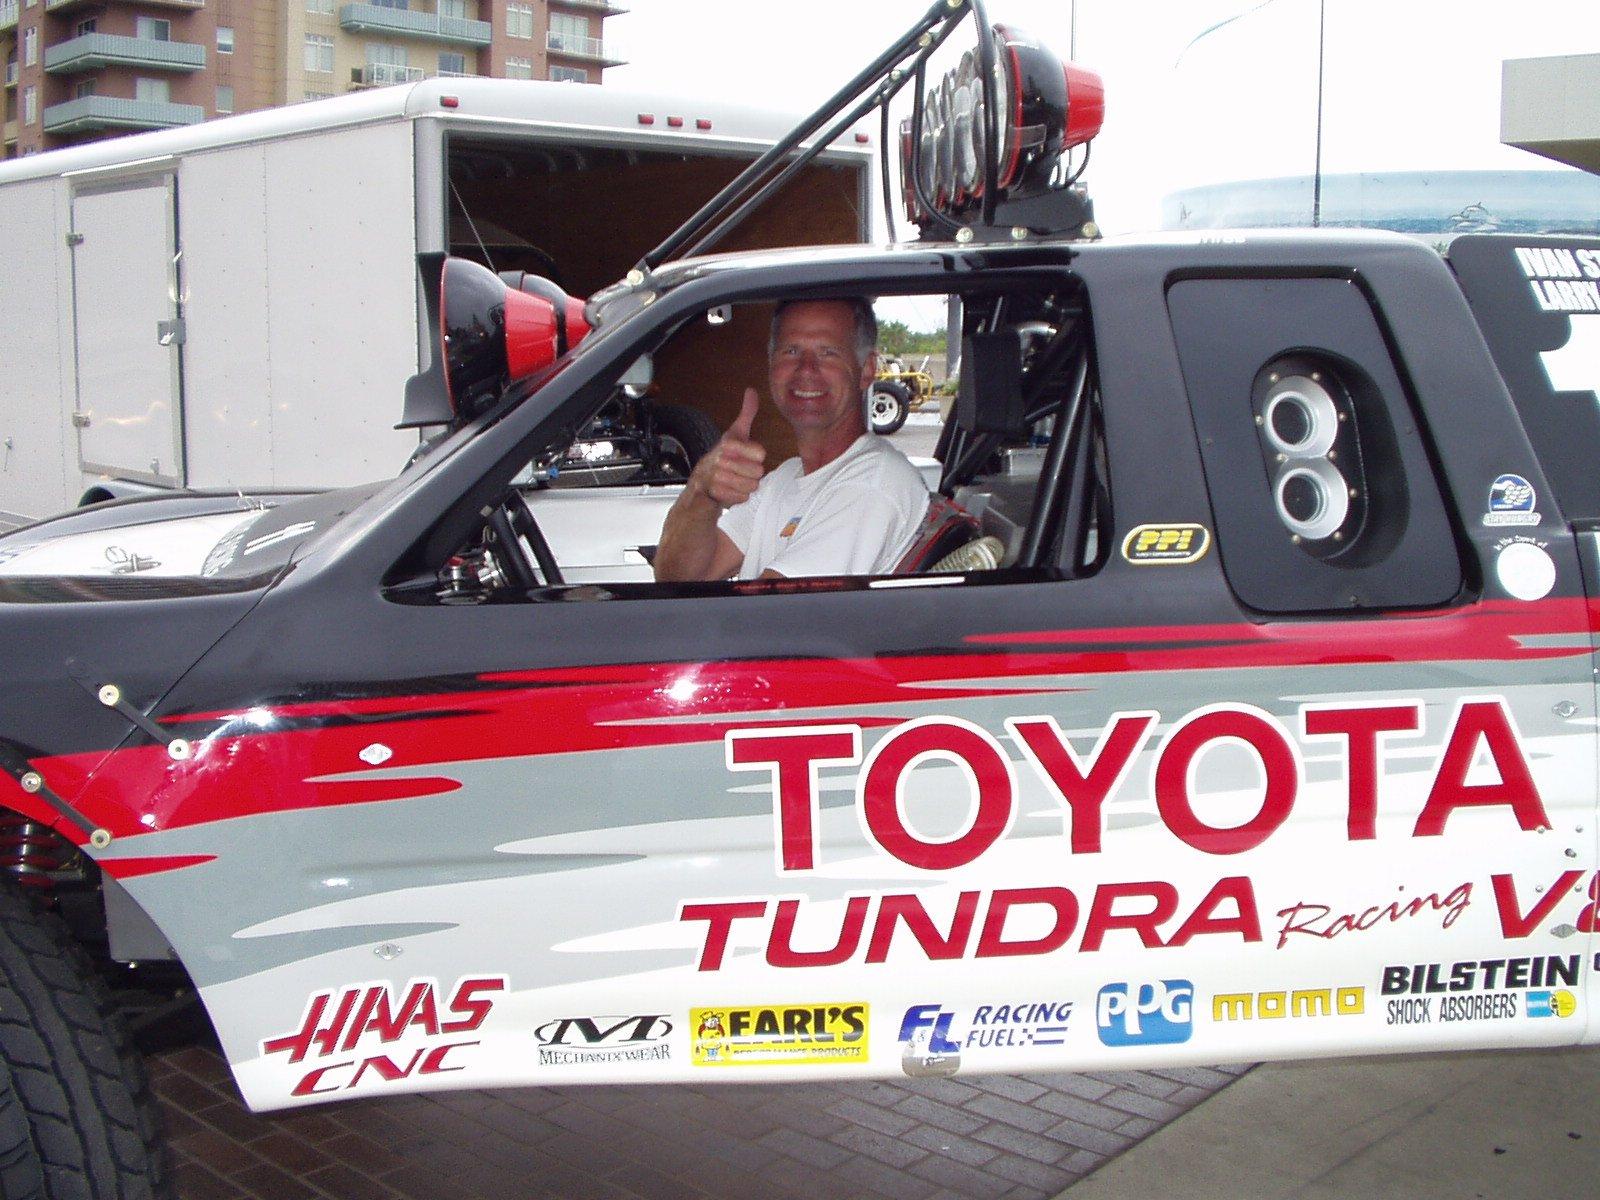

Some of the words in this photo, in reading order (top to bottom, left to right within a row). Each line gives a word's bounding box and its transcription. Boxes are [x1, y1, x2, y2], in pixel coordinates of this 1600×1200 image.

[1515, 247, 1582, 278] IVAN
[1135, 529, 1195, 552] PPI
[731, 702, 1550, 871] TOYOTA
[682, 876, 1262, 972] TUNDRA
[1277, 882, 1473, 950] Racing
[1381, 954, 1581, 996] BILSTEIN
[264, 978, 505, 1064] HAAS
[729, 1005, 865, 1046] EARL'S
[972, 1002, 1073, 1025] RACING
[1386, 998, 1431, 1026] SHOCK
[1439, 992, 1518, 1024] ABSORBERS
[965, 1029, 1015, 1048] FUEL
[290, 1041, 481, 1097] CNC
